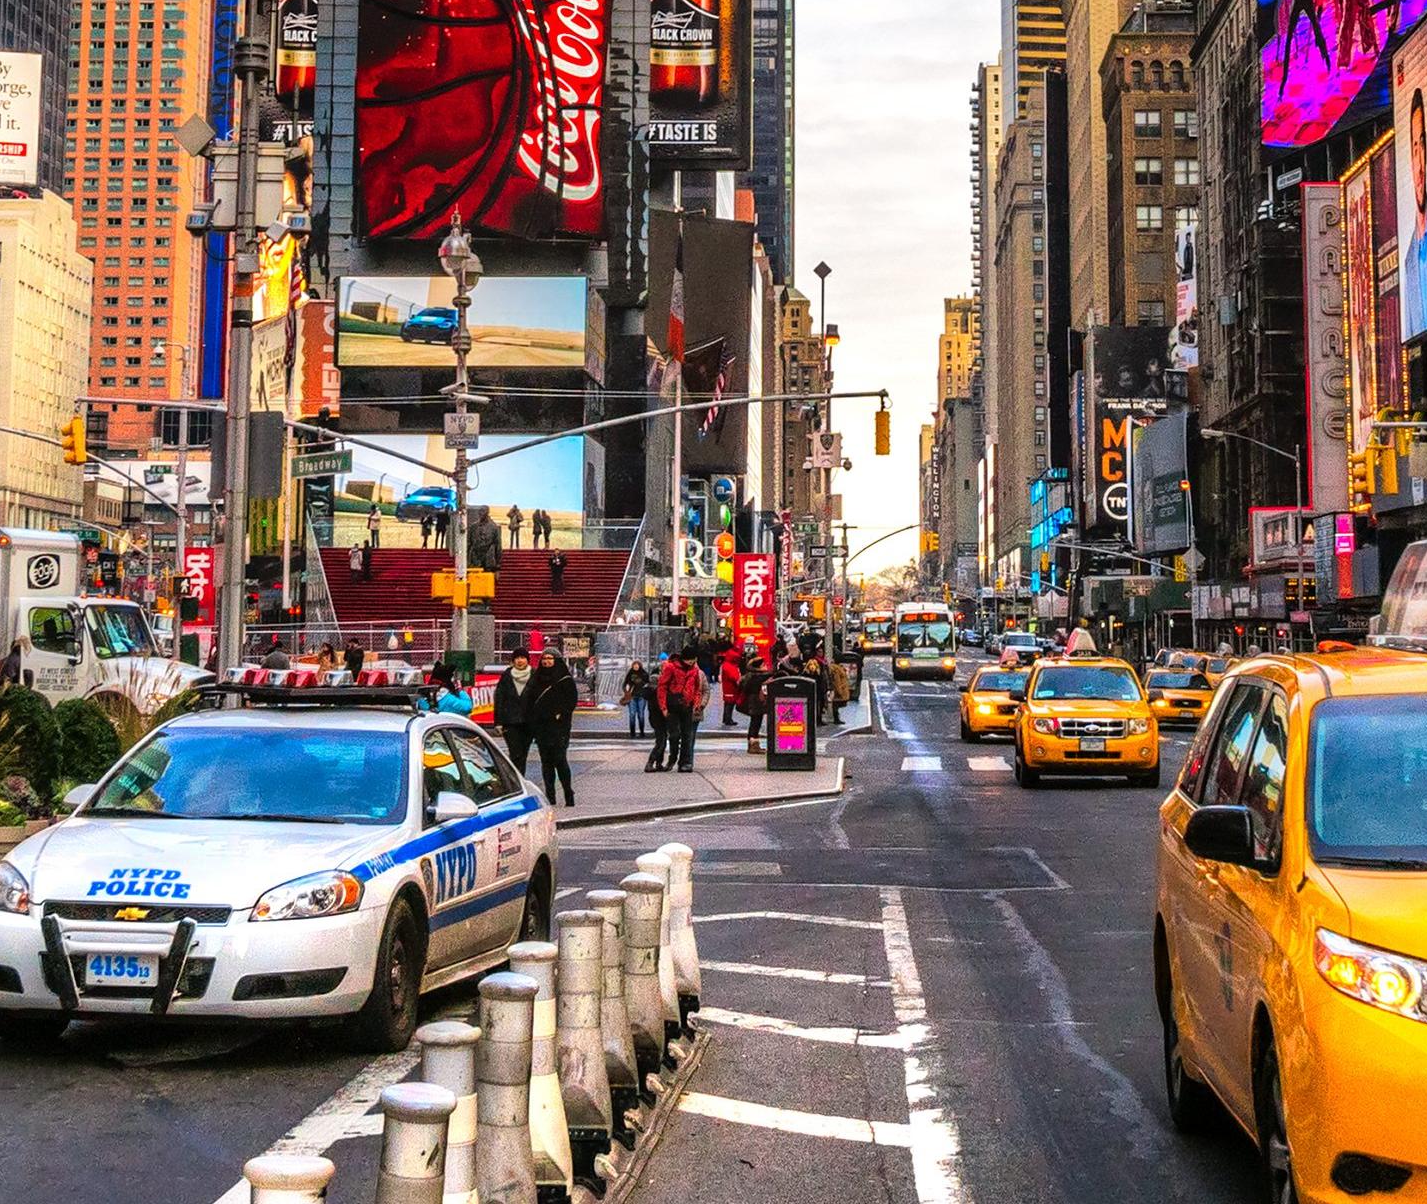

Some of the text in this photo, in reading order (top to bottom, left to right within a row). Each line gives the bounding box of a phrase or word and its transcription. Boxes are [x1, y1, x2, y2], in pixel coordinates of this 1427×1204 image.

[282, 30, 310, 43] BLACK
[652, 27, 713, 42] BLACK CROWN
[6, 115, 21, 131] it.
[703, 123, 718, 140] IS
[1318, 203, 1345, 441] PALACE
[297, 458, 343, 474] Broadway
[931, 446, 941, 519] WELLINGTON
[186, 552, 212, 604] tkts
[743, 558, 769, 609] tkts
[108, 867, 183, 881] NYPD
[435, 842, 477, 906] NYPD
[85, 881, 192, 899] POLICE
